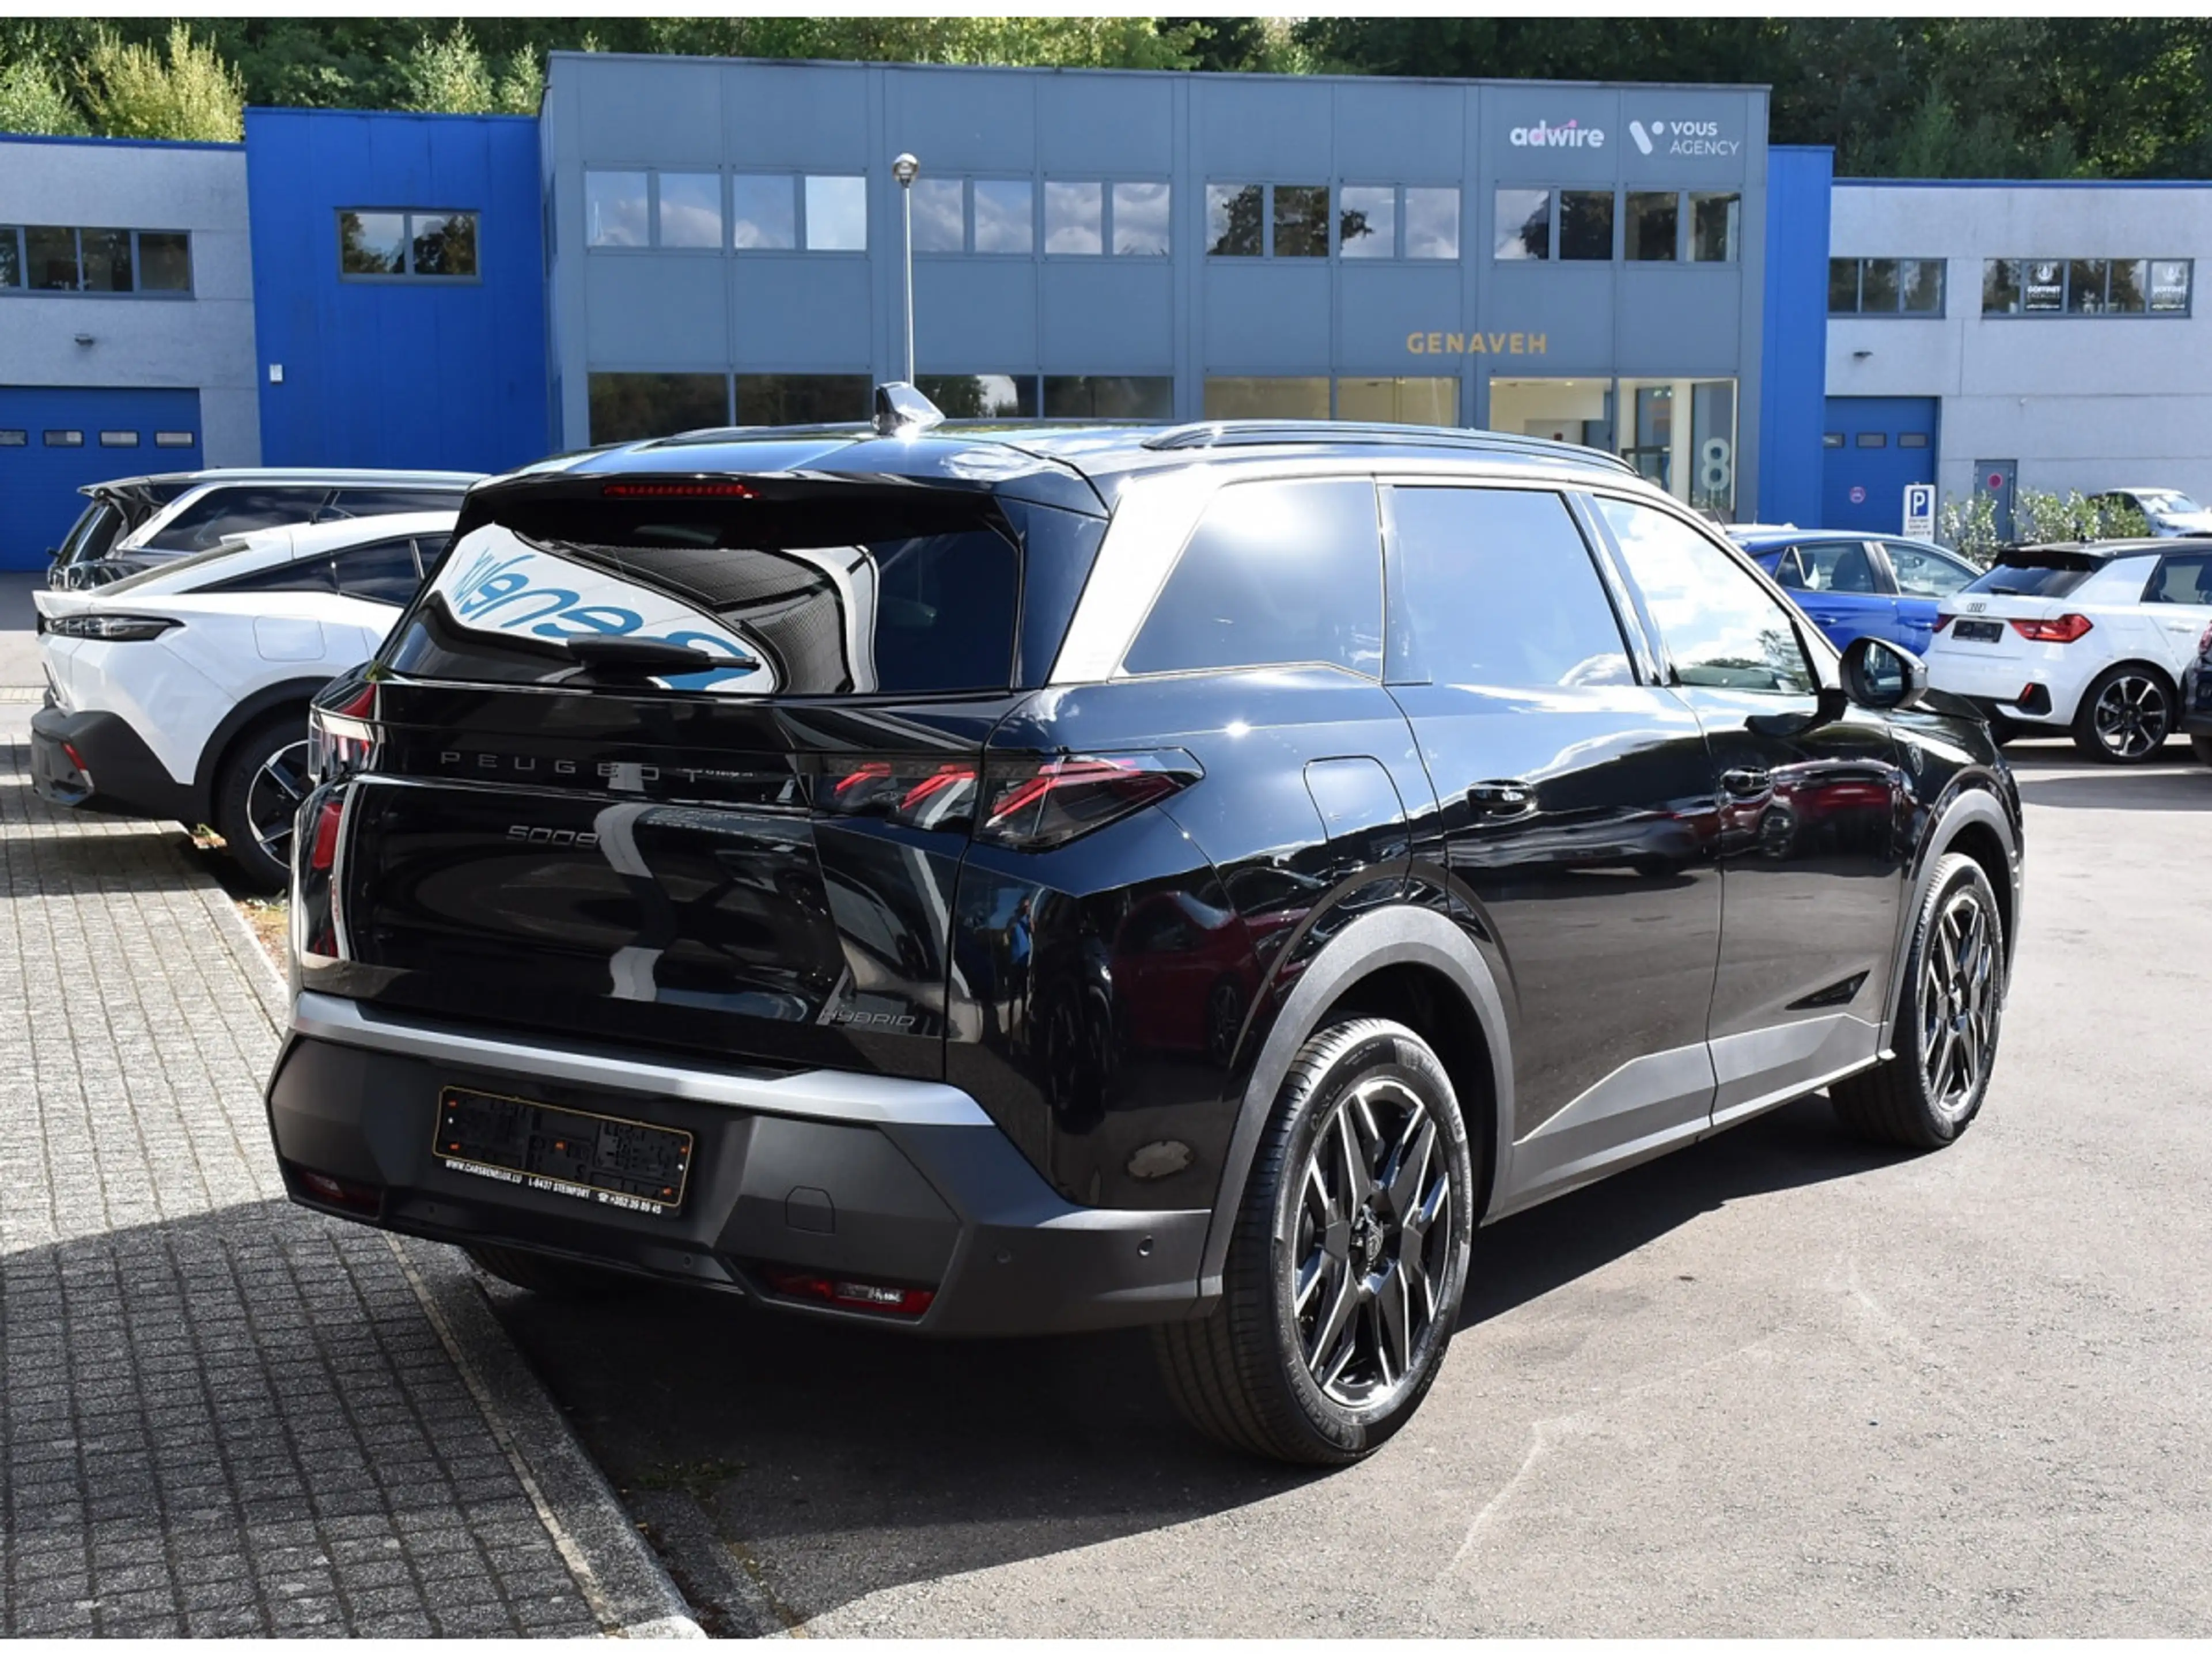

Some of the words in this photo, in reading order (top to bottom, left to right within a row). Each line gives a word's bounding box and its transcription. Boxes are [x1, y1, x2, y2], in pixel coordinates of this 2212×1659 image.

[1510, 119, 1605, 147] adwire
[1670, 122, 1717, 136] VOUS
[1670, 140, 1740, 156] AGENCY
[1407, 332, 1547, 354] GENAVEH
[1701, 437, 1730, 491] 8
[1913, 491, 1926, 516] P
[441, 752, 701, 782] PEUGEOT
[506, 825, 599, 849] 5008
[819, 1010, 916, 1026] HYBRID
